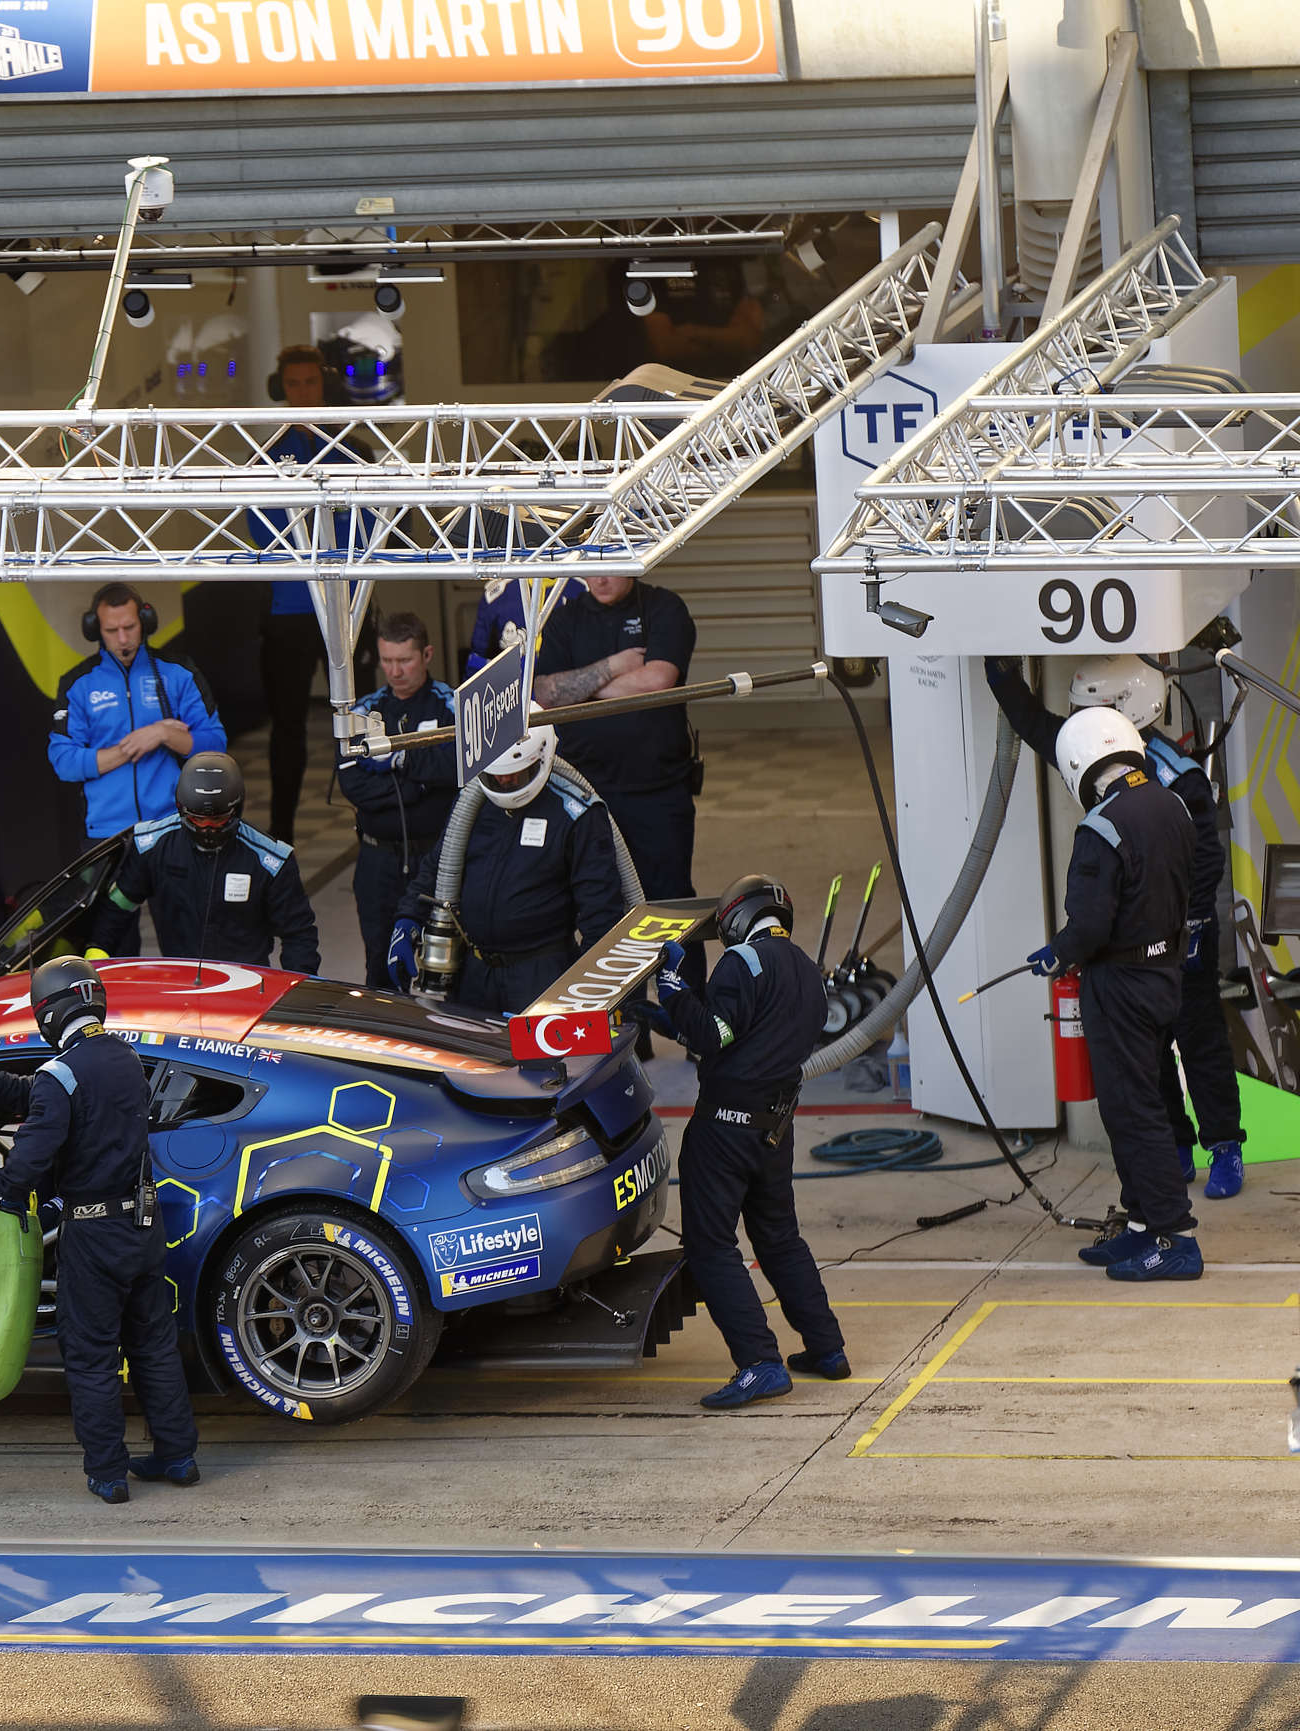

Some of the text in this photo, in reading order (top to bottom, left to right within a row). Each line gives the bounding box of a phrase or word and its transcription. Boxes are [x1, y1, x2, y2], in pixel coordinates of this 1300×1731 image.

[145, 0, 743, 66] ASTON MARTIN 90
[854, 403, 924, 444] TF
[1038, 577, 1138, 644] 90
[463, 678, 520, 769] 90 TF SPORT
[550, 915, 697, 1013] ESMOTOR
[178, 1036, 254, 1059] E. HANKEY
[459, 1223, 538, 1256] Lifestyle
[353, 1239, 410, 1318] MICHELIN
[470, 1264, 529, 1285] MICHELIN
[220, 1332, 279, 1408] MICHELIN
[6, 1591, 1300, 1629] MICHELIN
